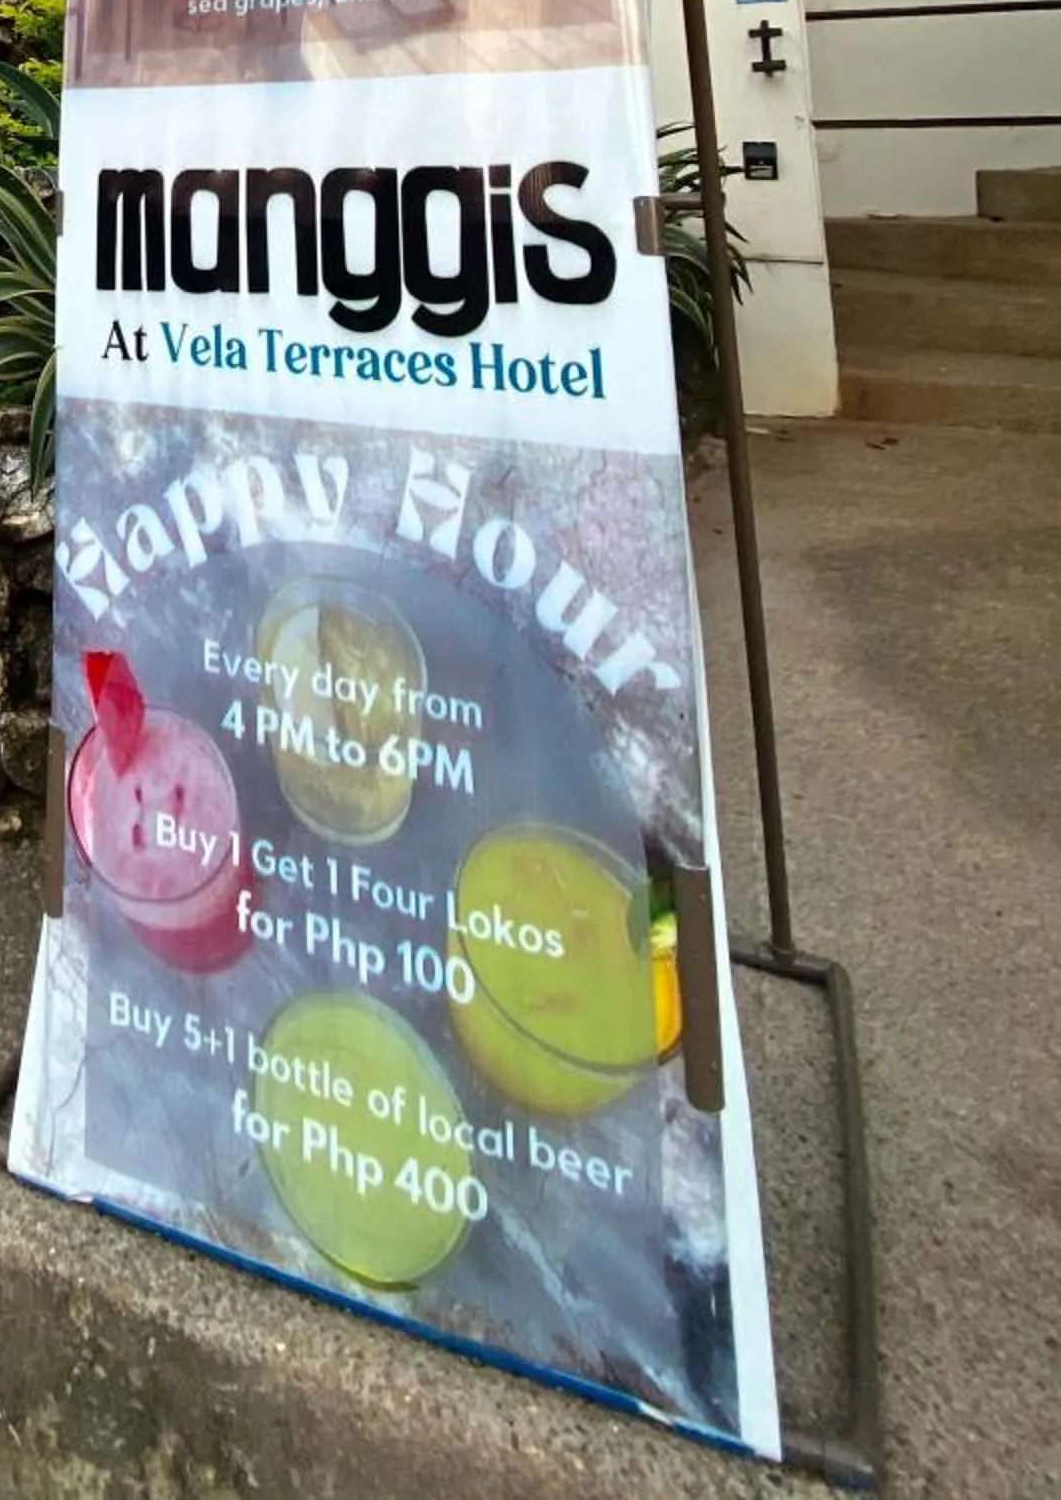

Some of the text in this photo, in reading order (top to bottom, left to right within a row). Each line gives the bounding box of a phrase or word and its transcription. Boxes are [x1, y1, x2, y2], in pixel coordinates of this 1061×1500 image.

[96, 160, 617, 338] manggis
[101, 320, 607, 400] At Vela Terraces Hotel
[55, 444, 682, 699] Happy Hour
[203, 639, 484, 731] Every day from
[221, 700, 476, 795] 4 PM to 6PM
[154, 813, 566, 960] Buy 1 Get 1 Four Lokos
[237, 891, 476, 1006] for Php 100
[109, 992, 634, 1196] Buy 5+1 bottle of local beer
[232, 1088, 489, 1222] for Php 400
